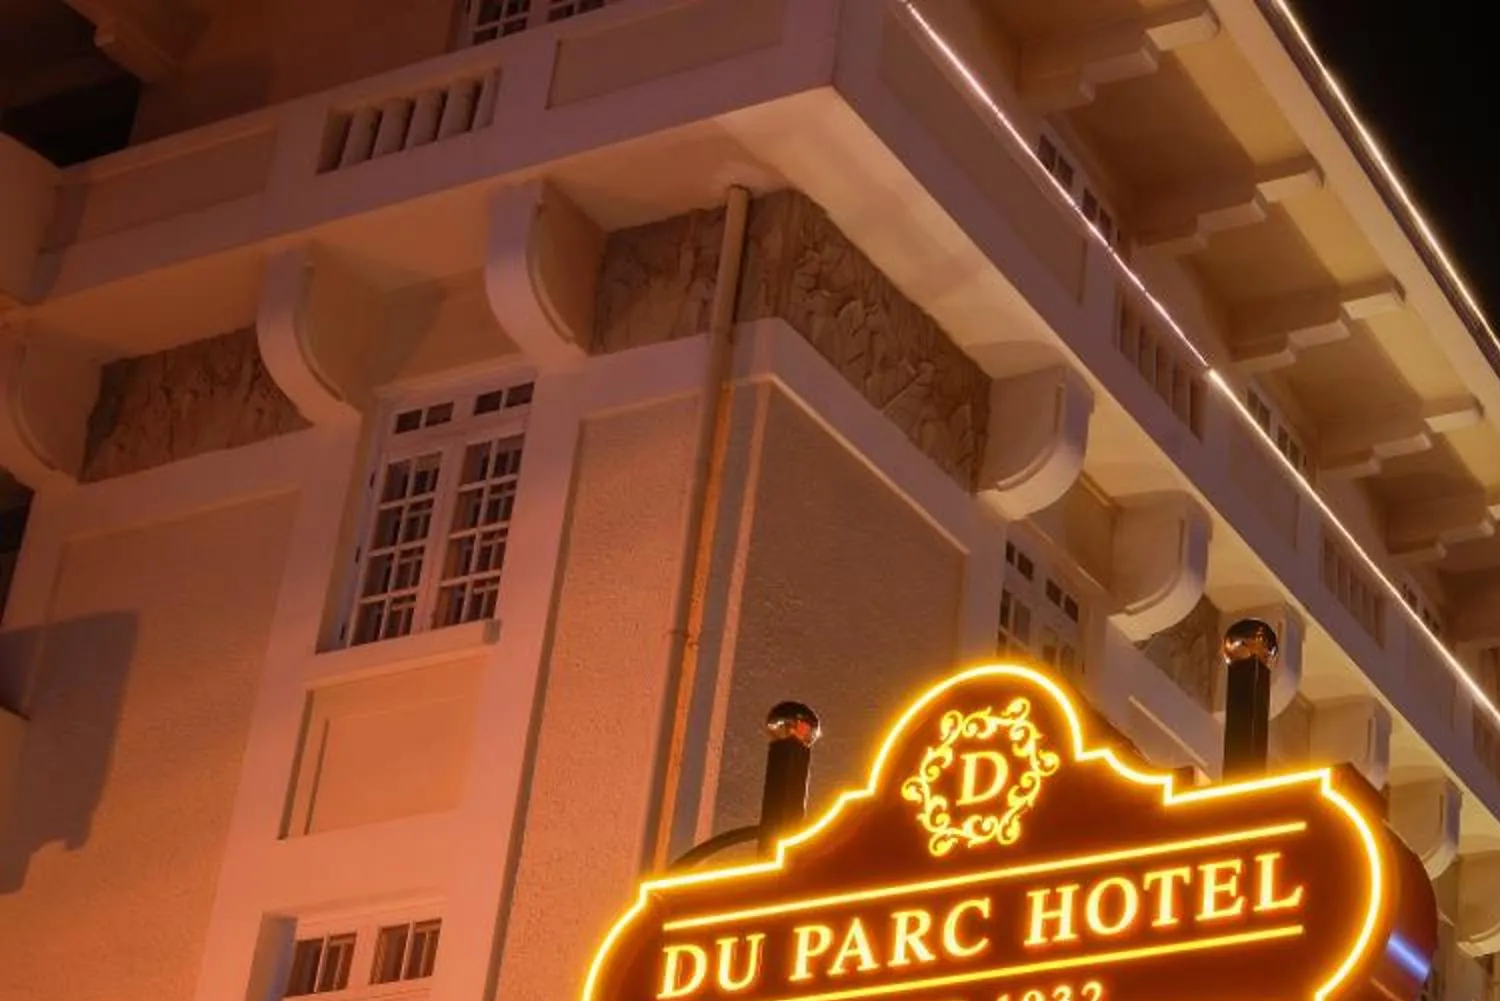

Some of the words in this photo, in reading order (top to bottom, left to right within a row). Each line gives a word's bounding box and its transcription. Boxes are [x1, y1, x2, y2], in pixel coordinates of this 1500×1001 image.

[956, 750, 1009, 807] D
[655, 932, 766, 1001] DU
[788, 896, 992, 982] PARC
[1022, 851, 1305, 948] HOTEL
